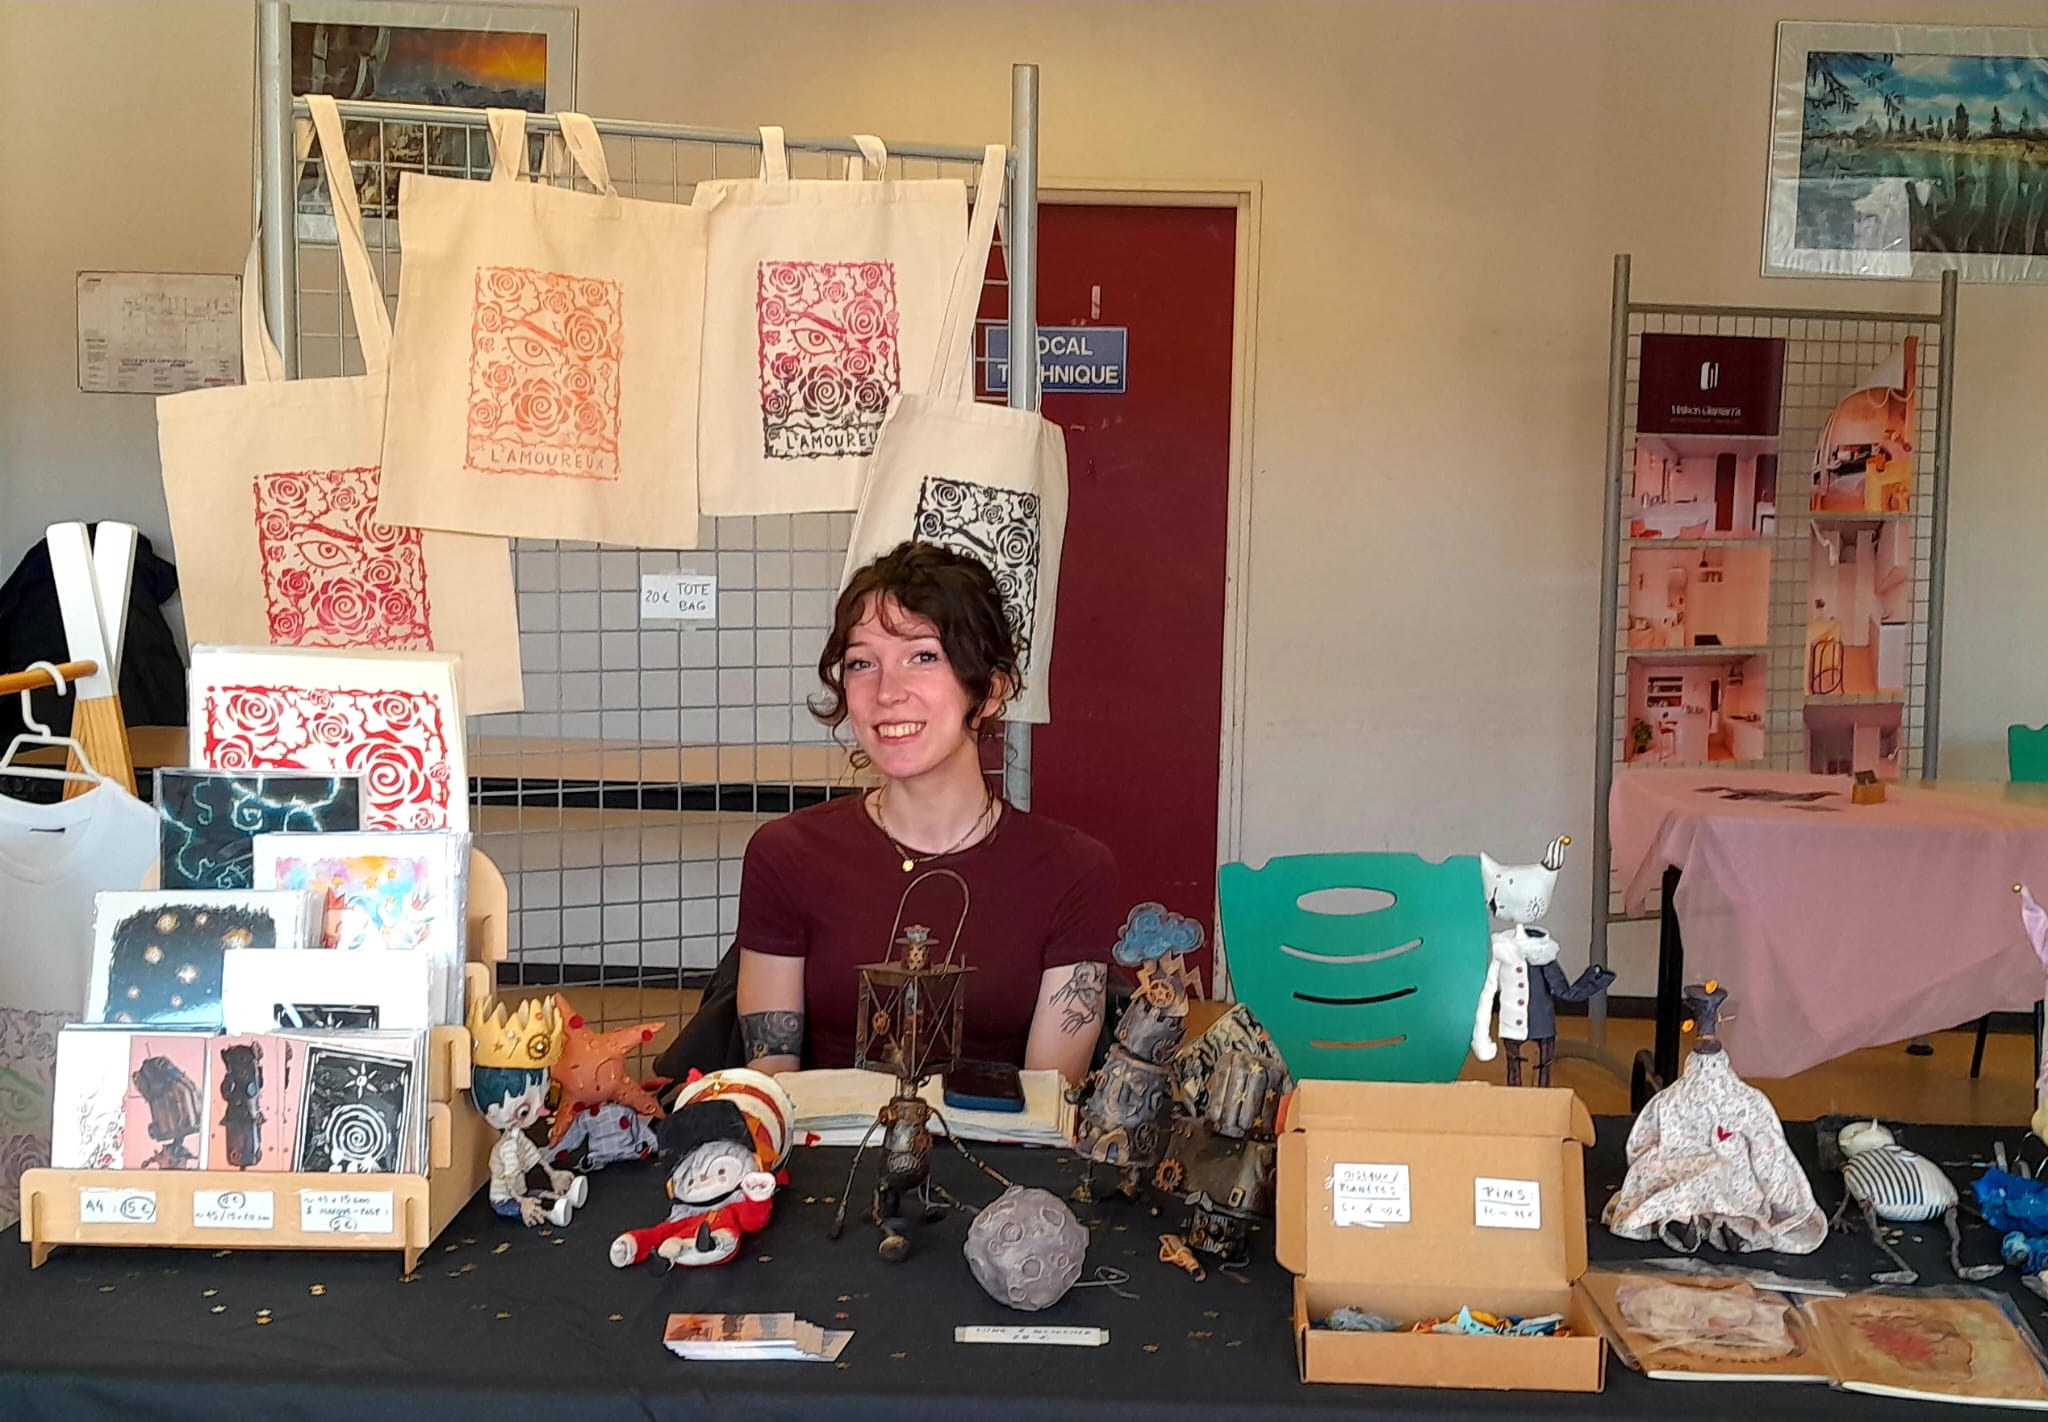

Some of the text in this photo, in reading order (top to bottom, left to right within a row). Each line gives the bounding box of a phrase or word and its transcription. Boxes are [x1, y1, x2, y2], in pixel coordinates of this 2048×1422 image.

[1036, 335, 1093, 356] OCAL
[997, 364, 1119, 385] THNIQUE
[786, 429, 878, 449] L'AMOUREU
[490, 447, 604, 470] L'AMOUREUX
[677, 582, 711, 596] TOTE
[679, 600, 706, 612] BAG
